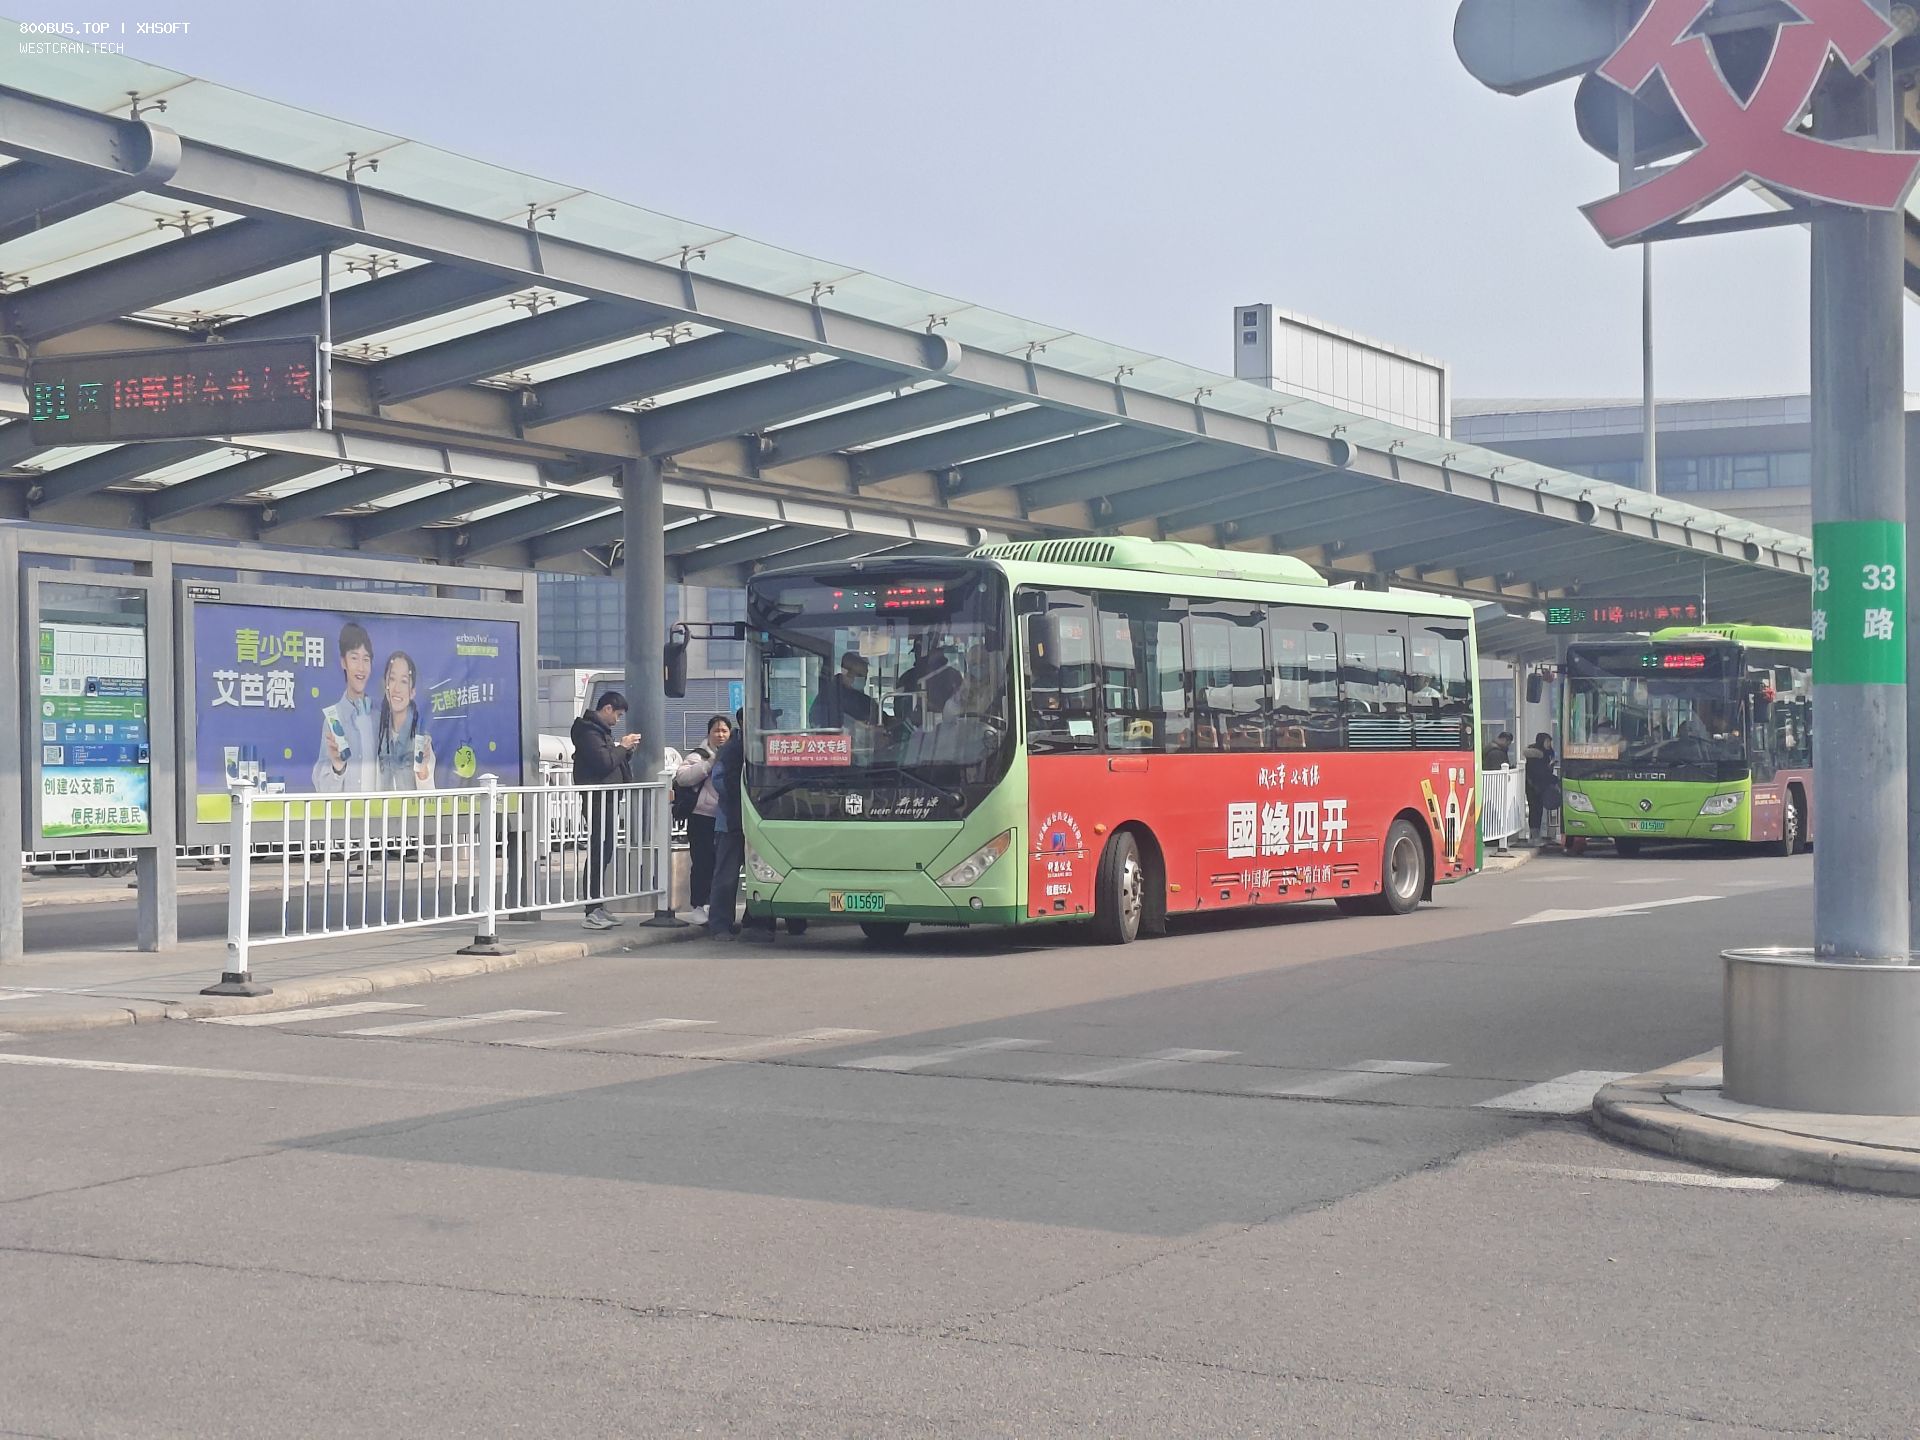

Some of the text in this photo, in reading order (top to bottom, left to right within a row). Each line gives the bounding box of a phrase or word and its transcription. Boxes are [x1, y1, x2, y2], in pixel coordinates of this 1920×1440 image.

[1861, 564, 1896, 591] 33
[1863, 607, 1895, 641] 路
[235, 628, 325, 667] 青少年用
[211, 669, 296, 709] 艾芭薇
[807, 740, 847, 754] 公交专线
[44, 777, 115, 795] 创建公交都市
[71, 807, 141, 825] 便民利民惠民
[870, 806, 930, 819] new energy
